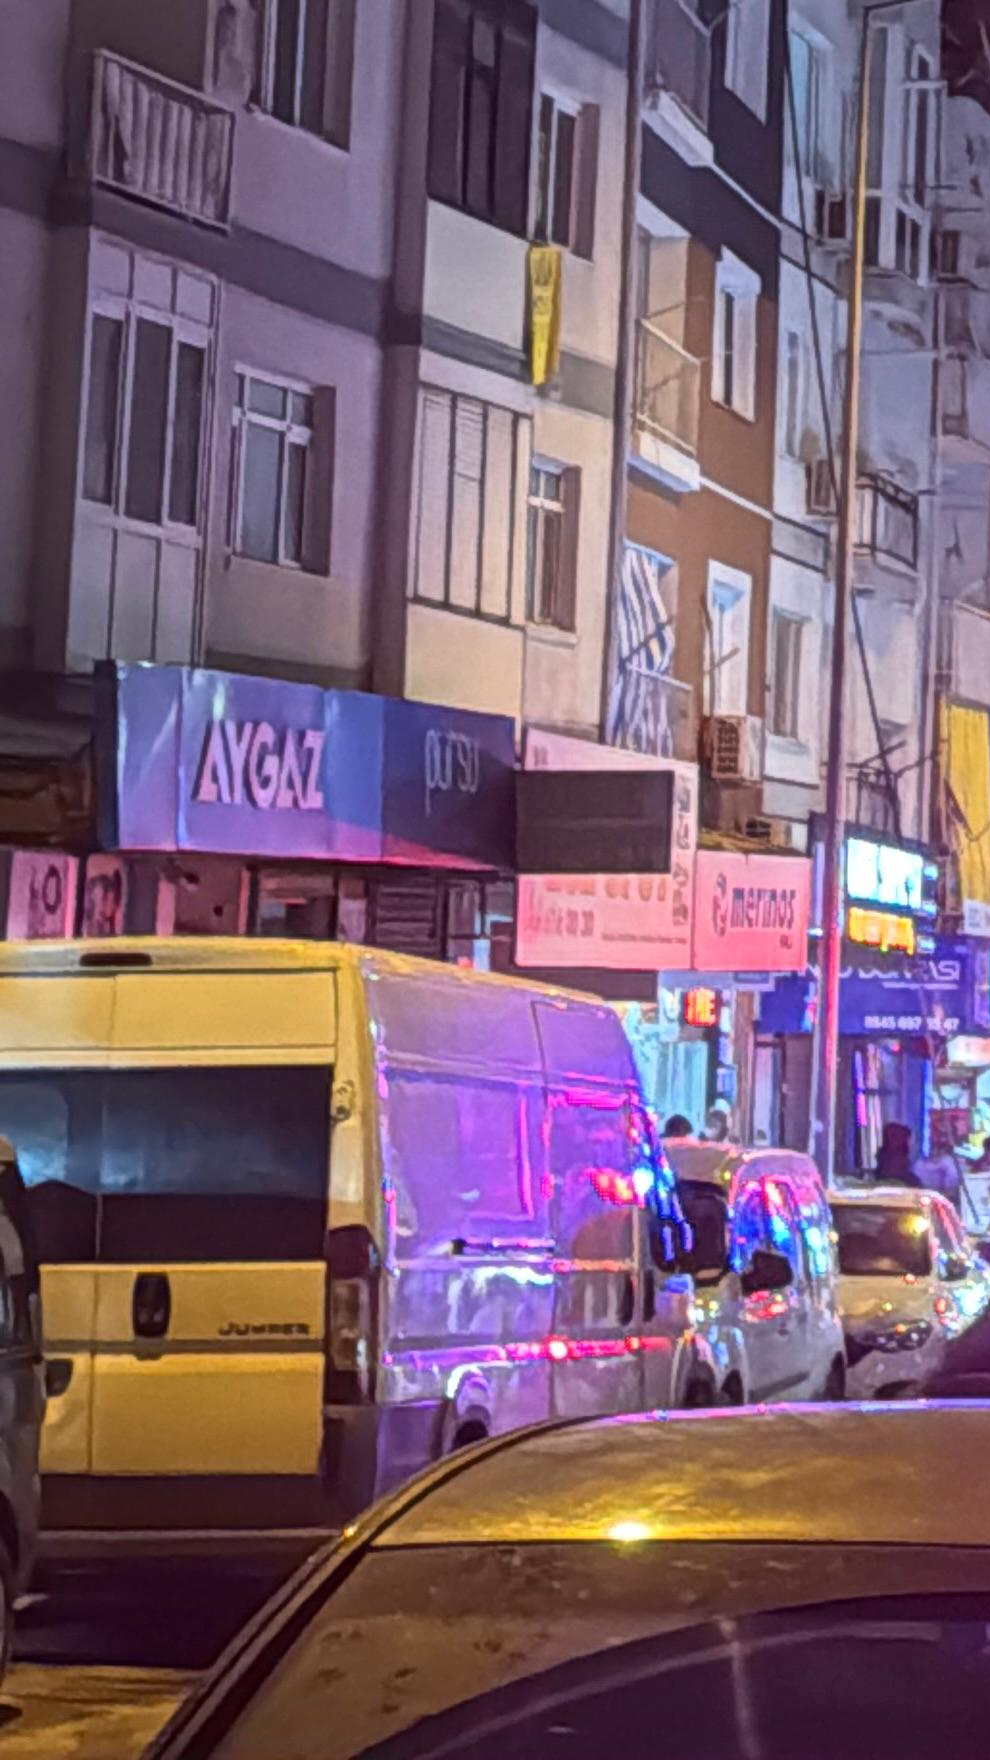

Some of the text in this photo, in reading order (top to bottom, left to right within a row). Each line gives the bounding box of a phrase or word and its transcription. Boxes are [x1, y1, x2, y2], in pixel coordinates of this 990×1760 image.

[195, 720, 326, 810] AYGAZ
[731, 887, 797, 930] merinos
[218, 1322, 310, 1336] JUMPER
